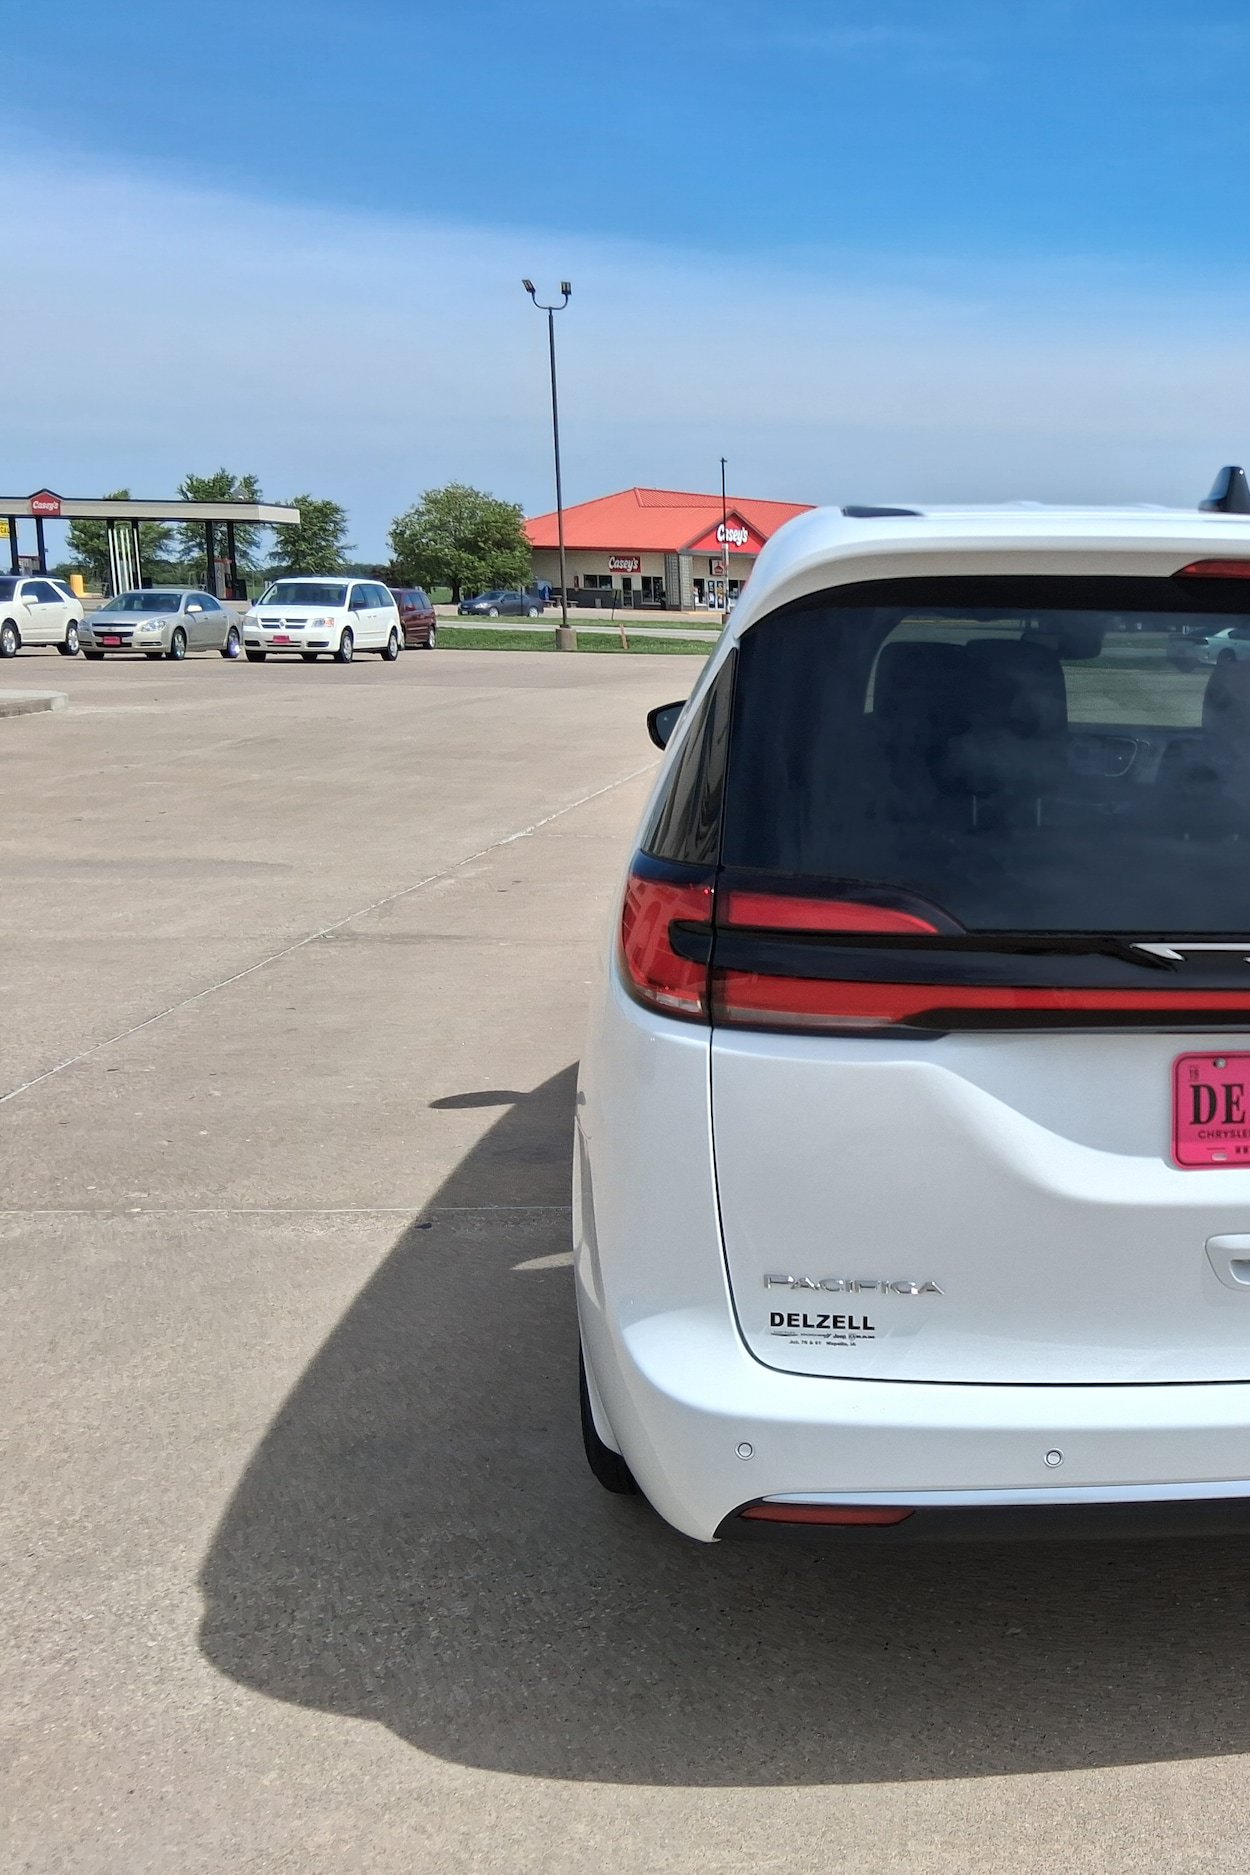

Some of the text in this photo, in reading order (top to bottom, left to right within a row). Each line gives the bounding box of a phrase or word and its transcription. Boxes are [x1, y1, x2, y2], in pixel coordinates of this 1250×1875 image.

[32, 500, 59, 511] Casey's
[716, 523, 749, 547] Casey's
[608, 556, 639, 572] Casey's
[763, 1273, 945, 1296] PACIFICA
[770, 1312, 875, 1331] DELZELL
